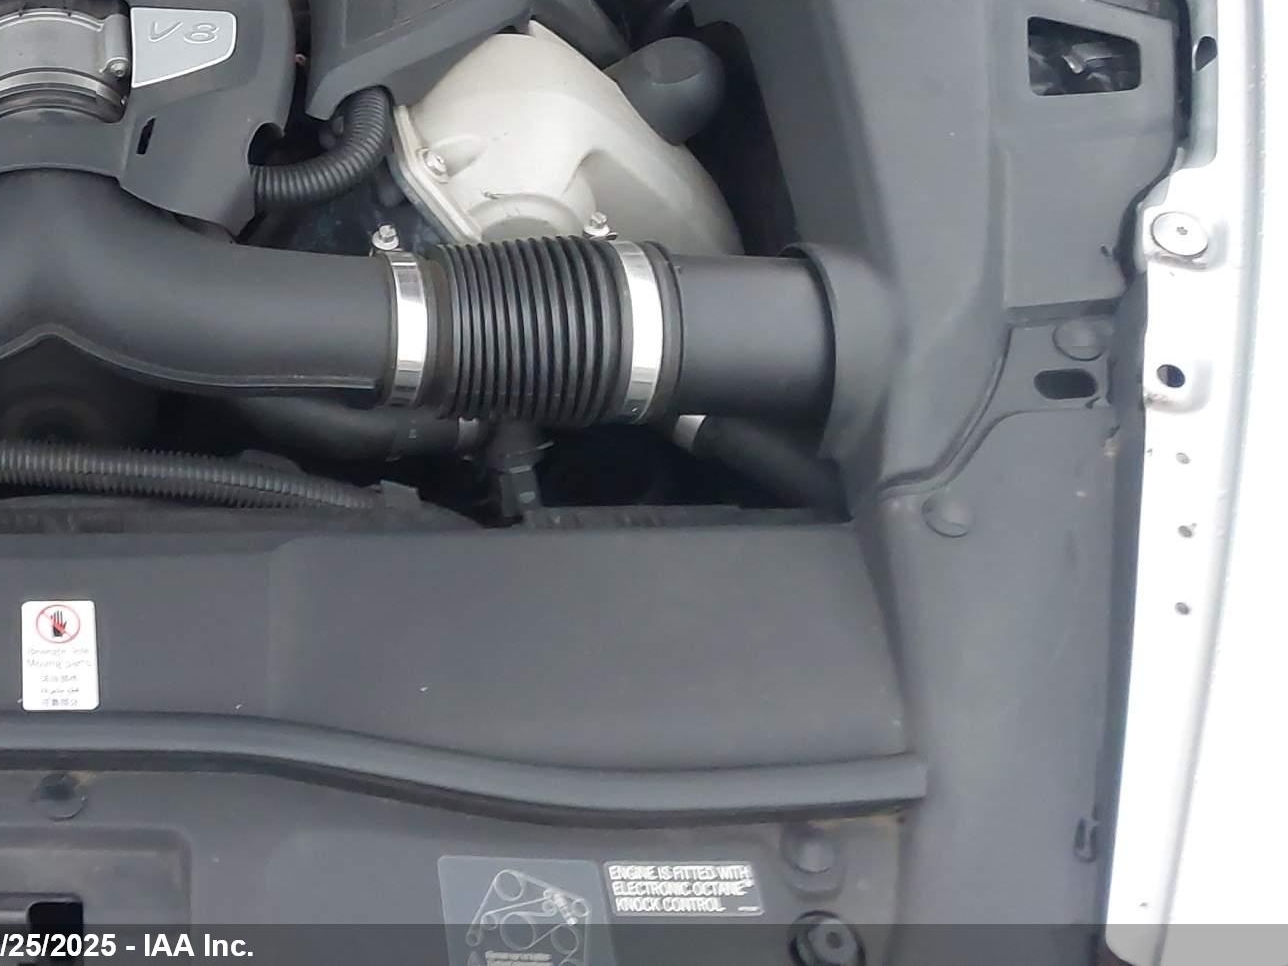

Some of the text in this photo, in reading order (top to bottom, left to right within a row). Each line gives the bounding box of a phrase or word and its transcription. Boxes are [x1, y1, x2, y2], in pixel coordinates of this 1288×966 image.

[148, 20, 220, 45] V8
[608, 865, 753, 880] ENGINE IS FITTED WITH
[612, 881, 691, 896] ELECTRONIC
[615, 897, 726, 912] KNOCK CONTROL
